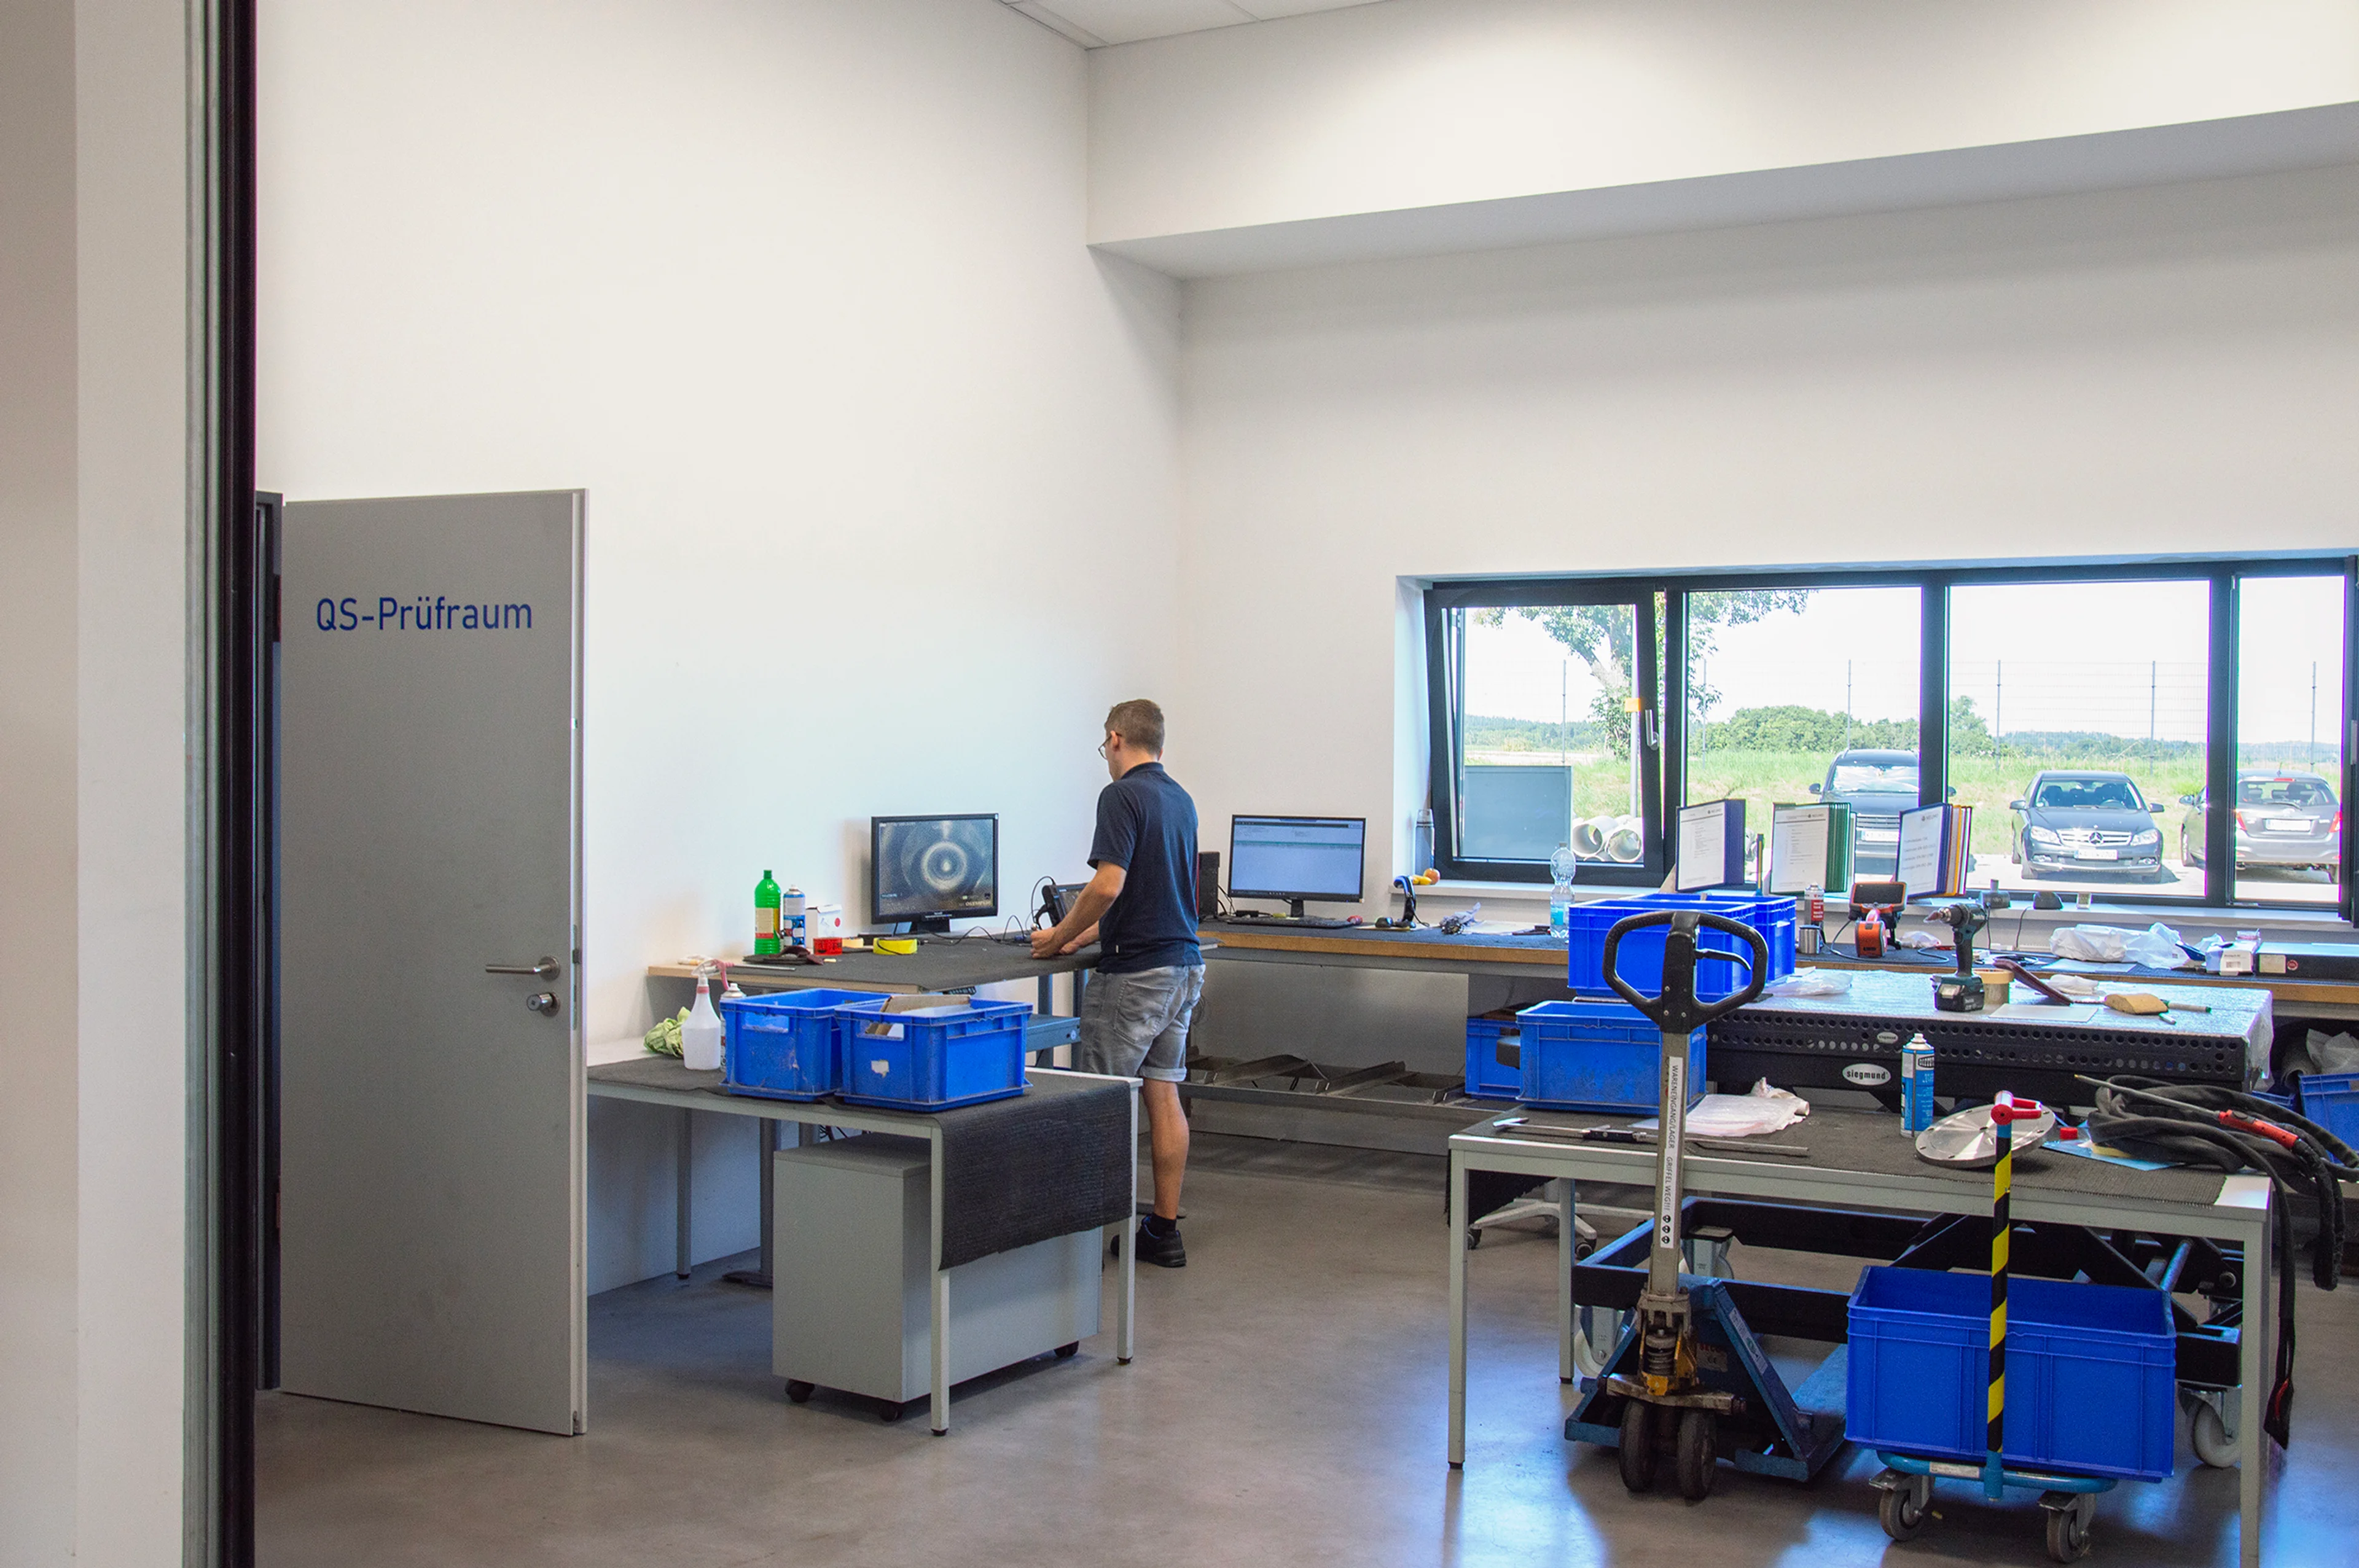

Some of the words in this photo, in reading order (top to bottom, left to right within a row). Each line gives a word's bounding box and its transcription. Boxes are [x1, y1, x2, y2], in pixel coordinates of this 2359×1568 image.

[316, 596, 533, 631] QS-Prüfraum
[1846, 1069, 1886, 1080] siegmund
[1668, 1065, 1679, 1149] WARENEINGANG/LAGER
